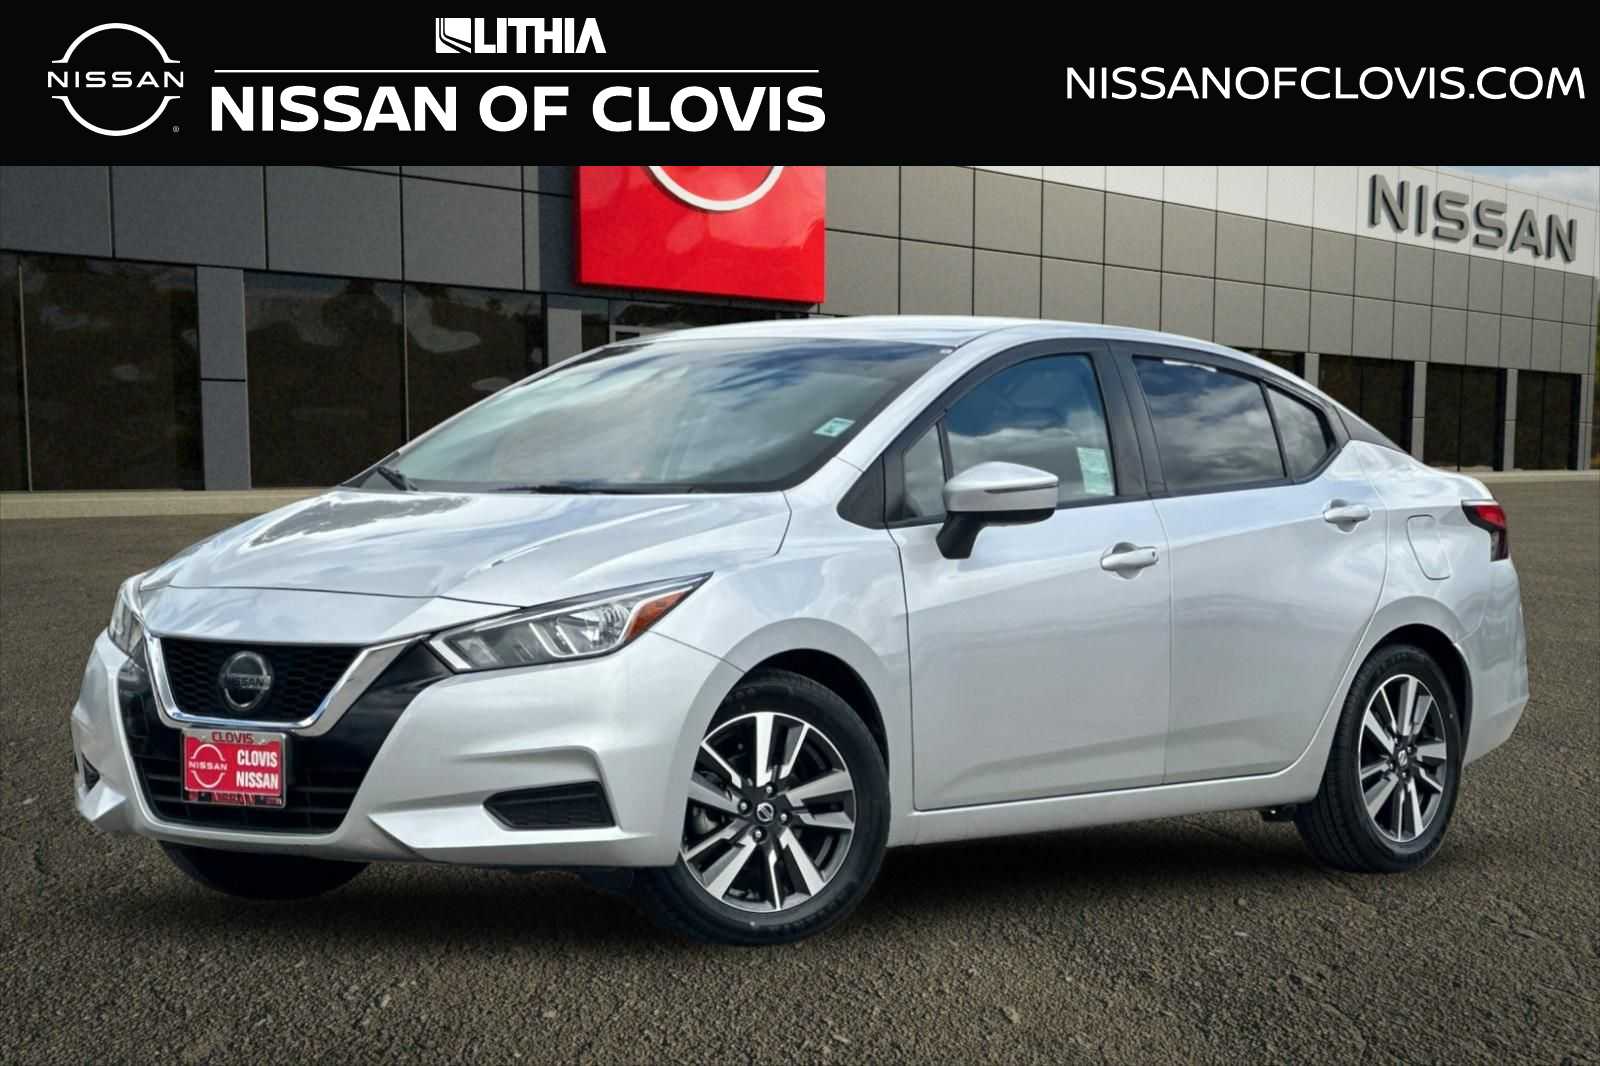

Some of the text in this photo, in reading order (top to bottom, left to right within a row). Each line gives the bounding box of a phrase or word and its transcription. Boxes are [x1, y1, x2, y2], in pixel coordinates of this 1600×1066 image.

[1368, 173, 1577, 263] NISSAN
[188, 760, 228, 771] NISSAN
[236, 749, 278, 768] CLOVIS
[236, 771, 279, 789] NISSAN
